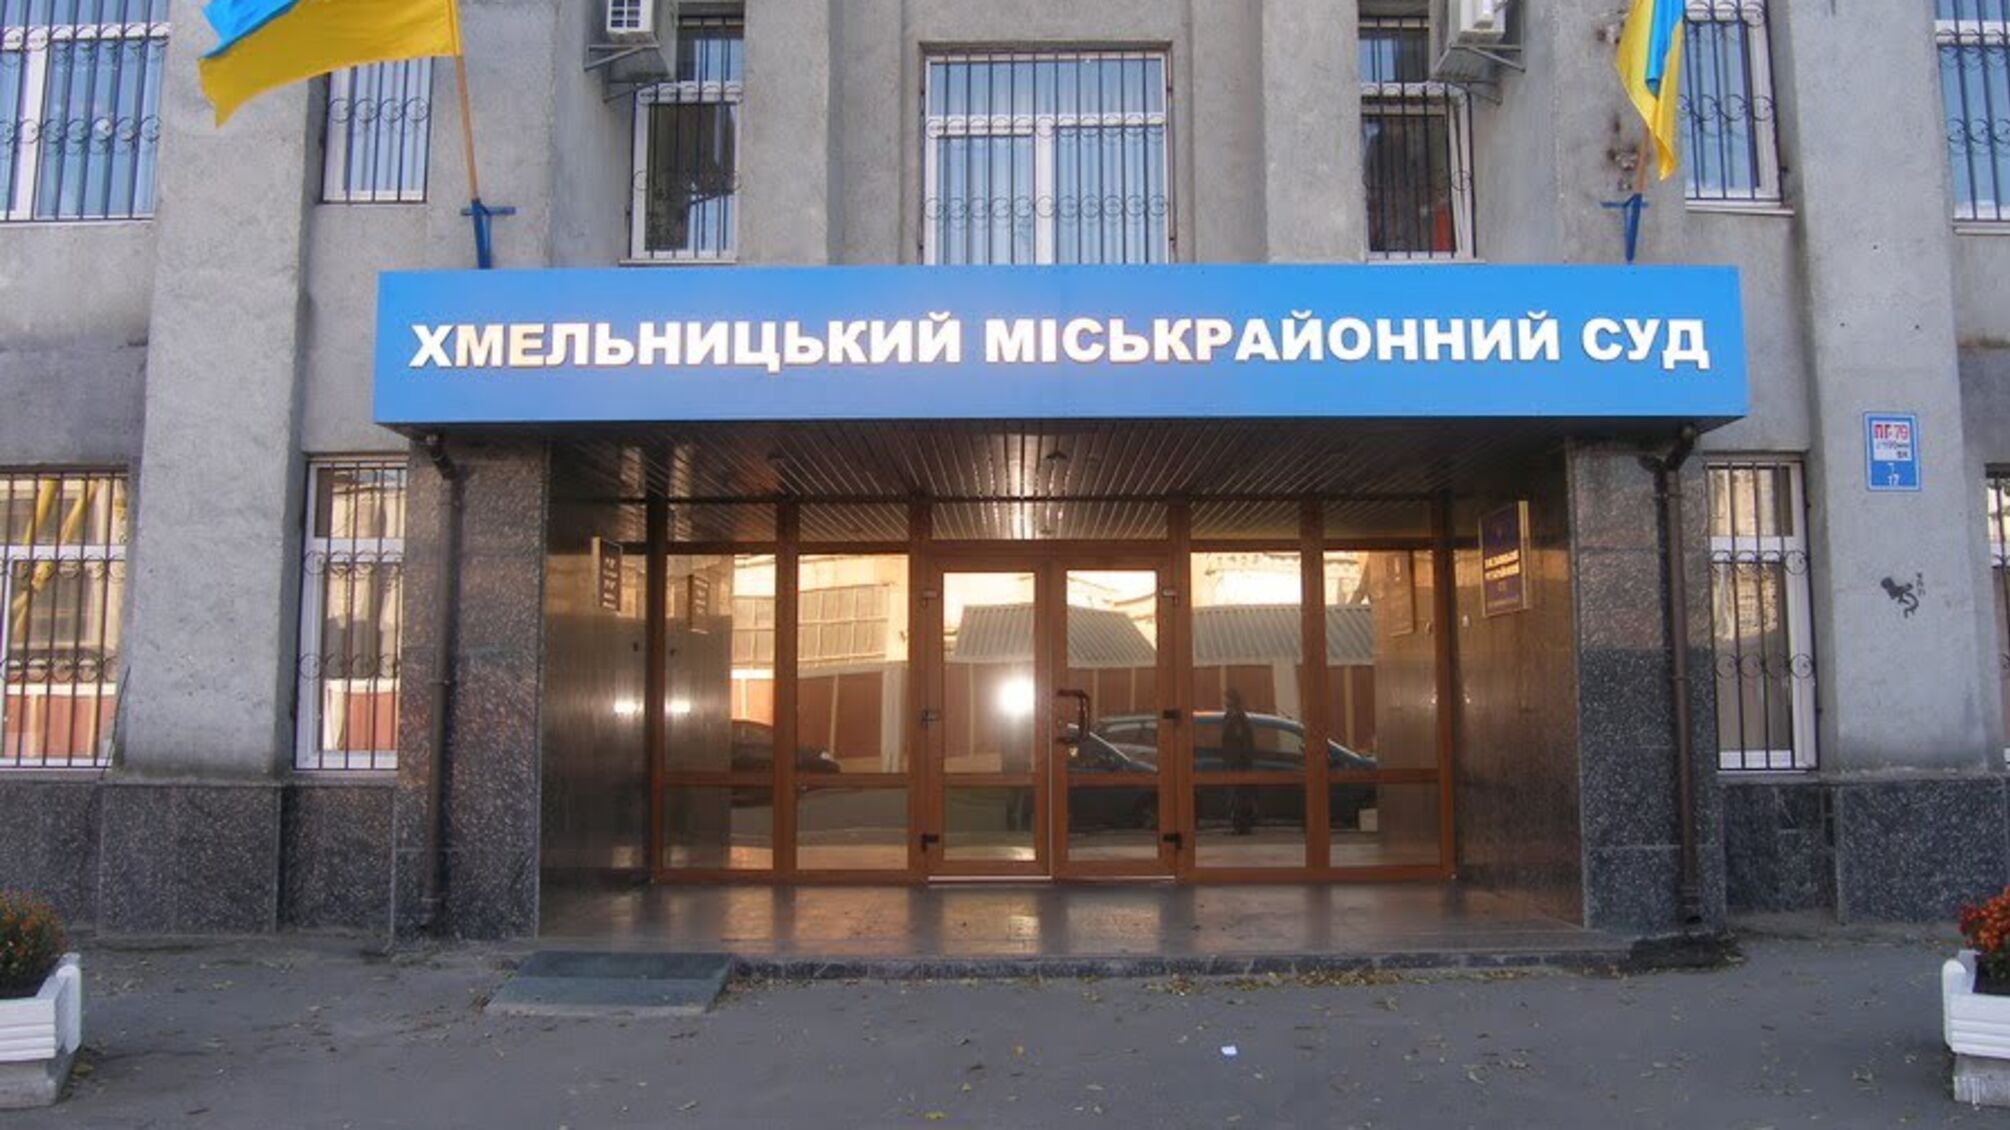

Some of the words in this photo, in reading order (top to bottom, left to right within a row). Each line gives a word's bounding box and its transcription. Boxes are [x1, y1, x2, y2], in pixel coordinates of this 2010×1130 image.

[409, 311, 961, 373] ХМЕЛЬНИЦЬКИЙ
[984, 311, 1559, 364] МІСЬКРАЙОННИЙ
[1582, 318, 1711, 369] СУД
